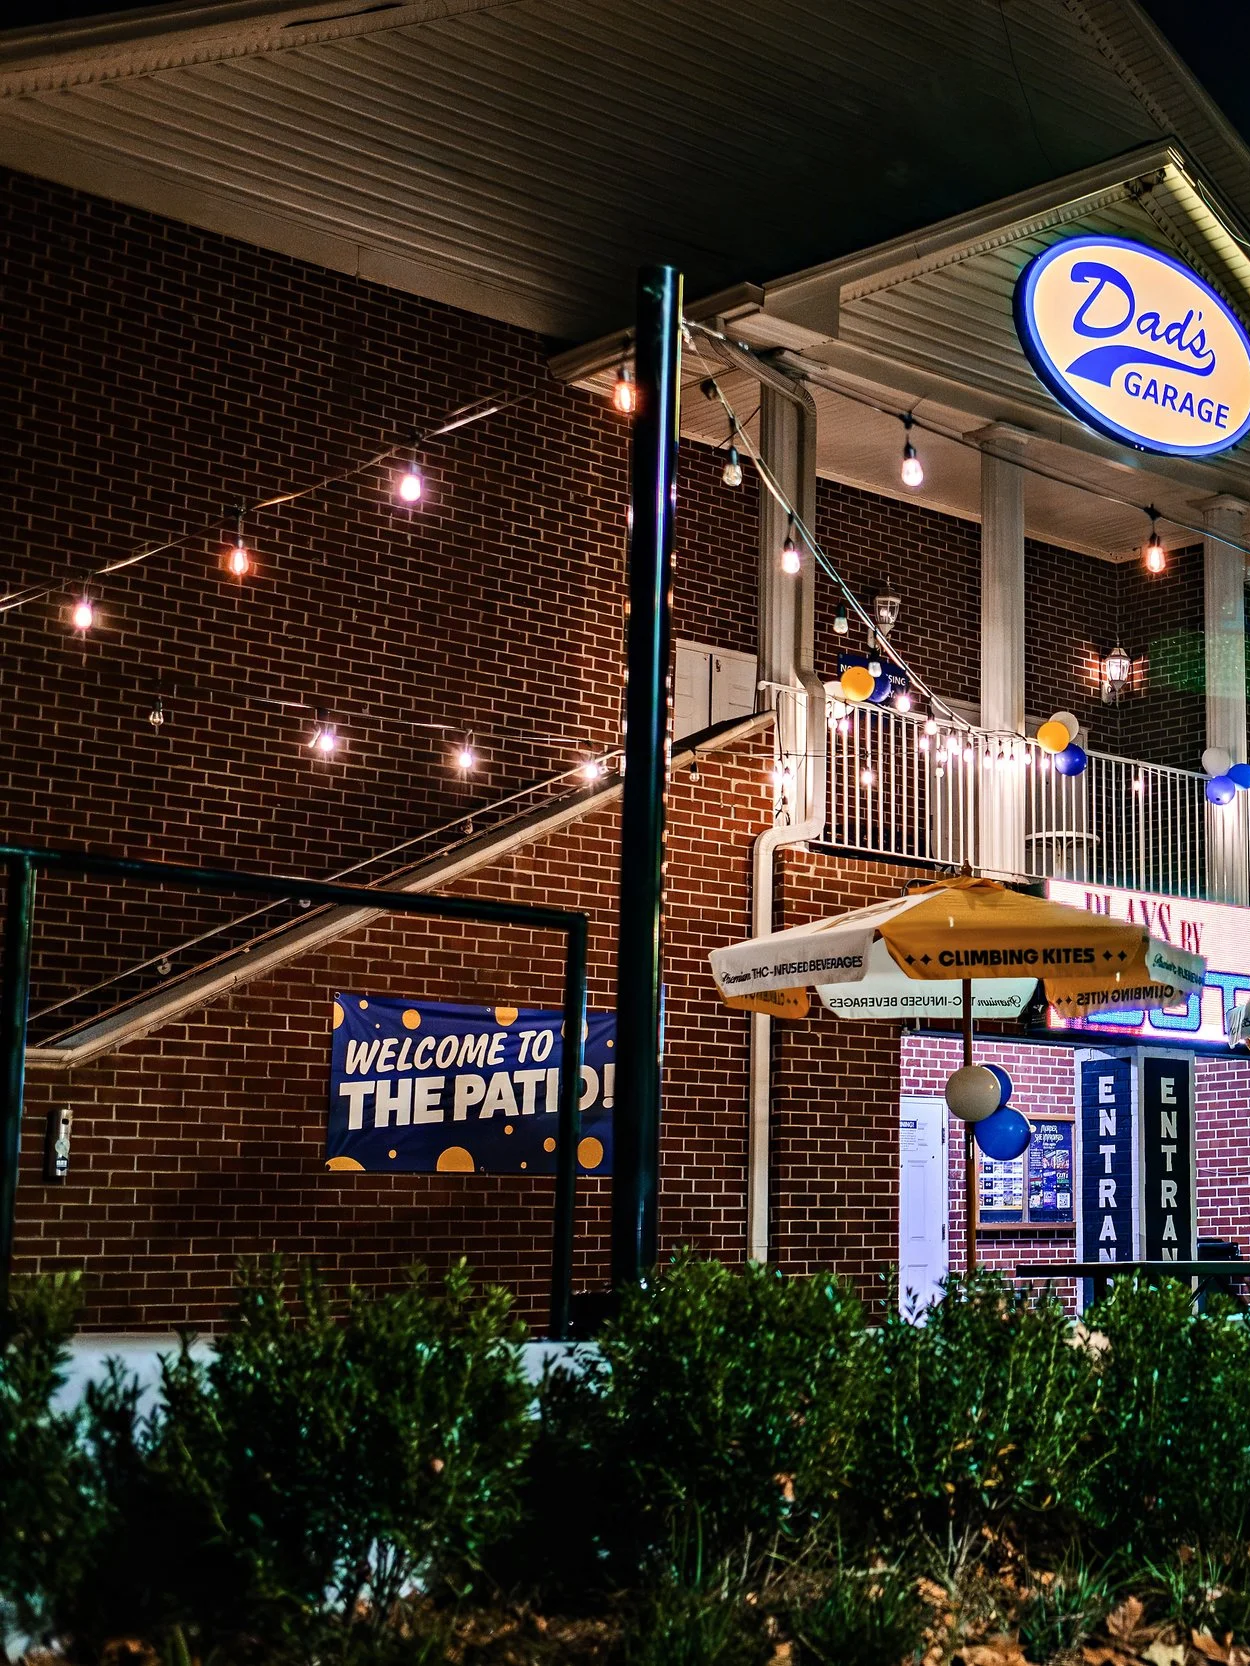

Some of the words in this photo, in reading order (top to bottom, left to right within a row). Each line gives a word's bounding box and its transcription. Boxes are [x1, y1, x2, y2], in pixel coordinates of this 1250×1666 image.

[1070, 261, 1216, 359] Dad's
[1124, 371, 1230, 429] GARAGE
[752, 961, 808, 980] THC-INFUSED
[809, 955, 864, 971] BEVERAGES
[939, 949, 1039, 967] CLIMBING
[1043, 948, 1096, 964] KITES
[345, 1032, 508, 1076] WELCOME
[518, 1029, 554, 1064] TO
[339, 1075, 447, 1131] THE
